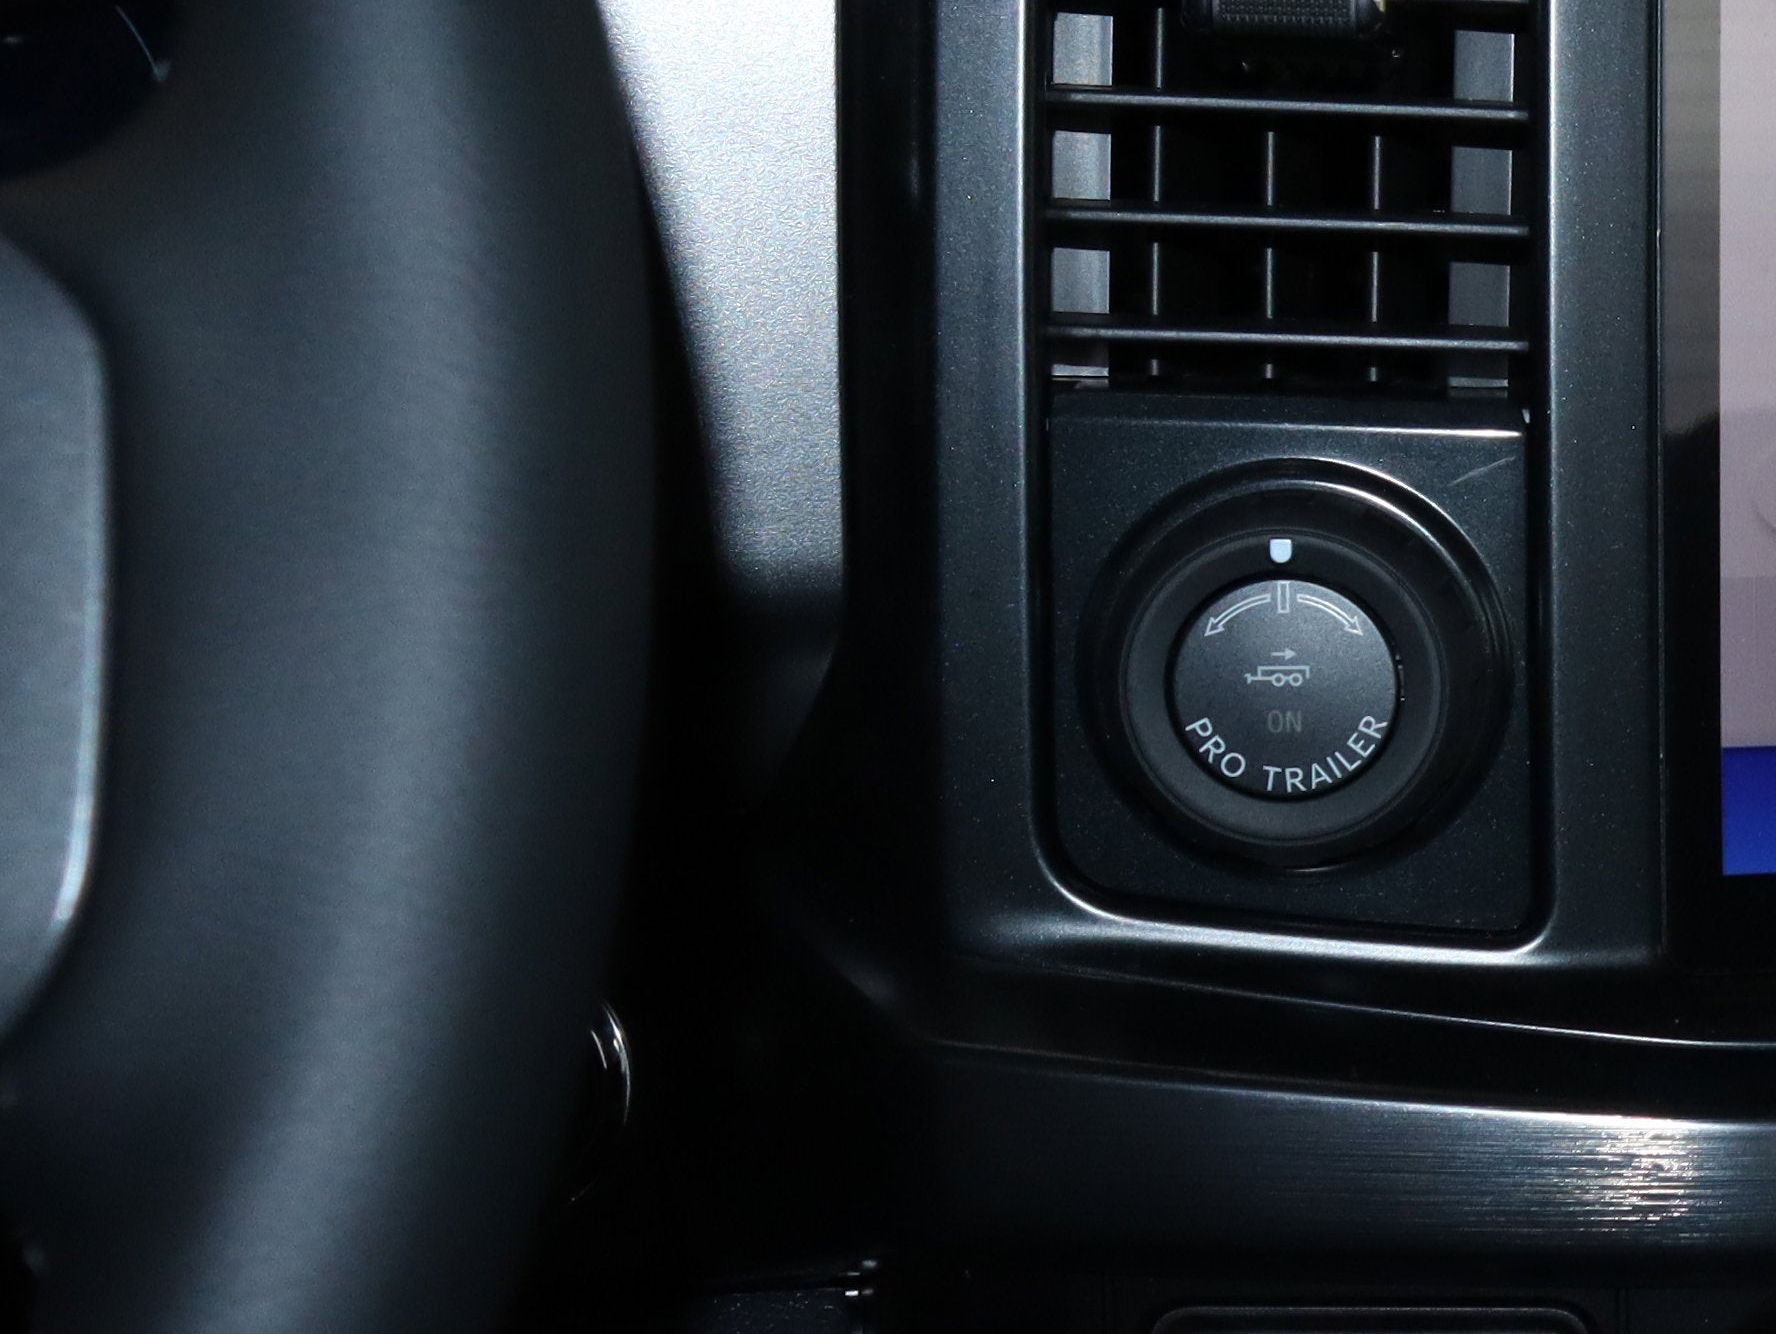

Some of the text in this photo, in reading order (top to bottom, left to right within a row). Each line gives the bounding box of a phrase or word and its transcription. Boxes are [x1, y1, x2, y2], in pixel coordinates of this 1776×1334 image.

[1266, 710, 1303, 734] ON
[1185, 714, 1389, 794] PRO TRAILER
